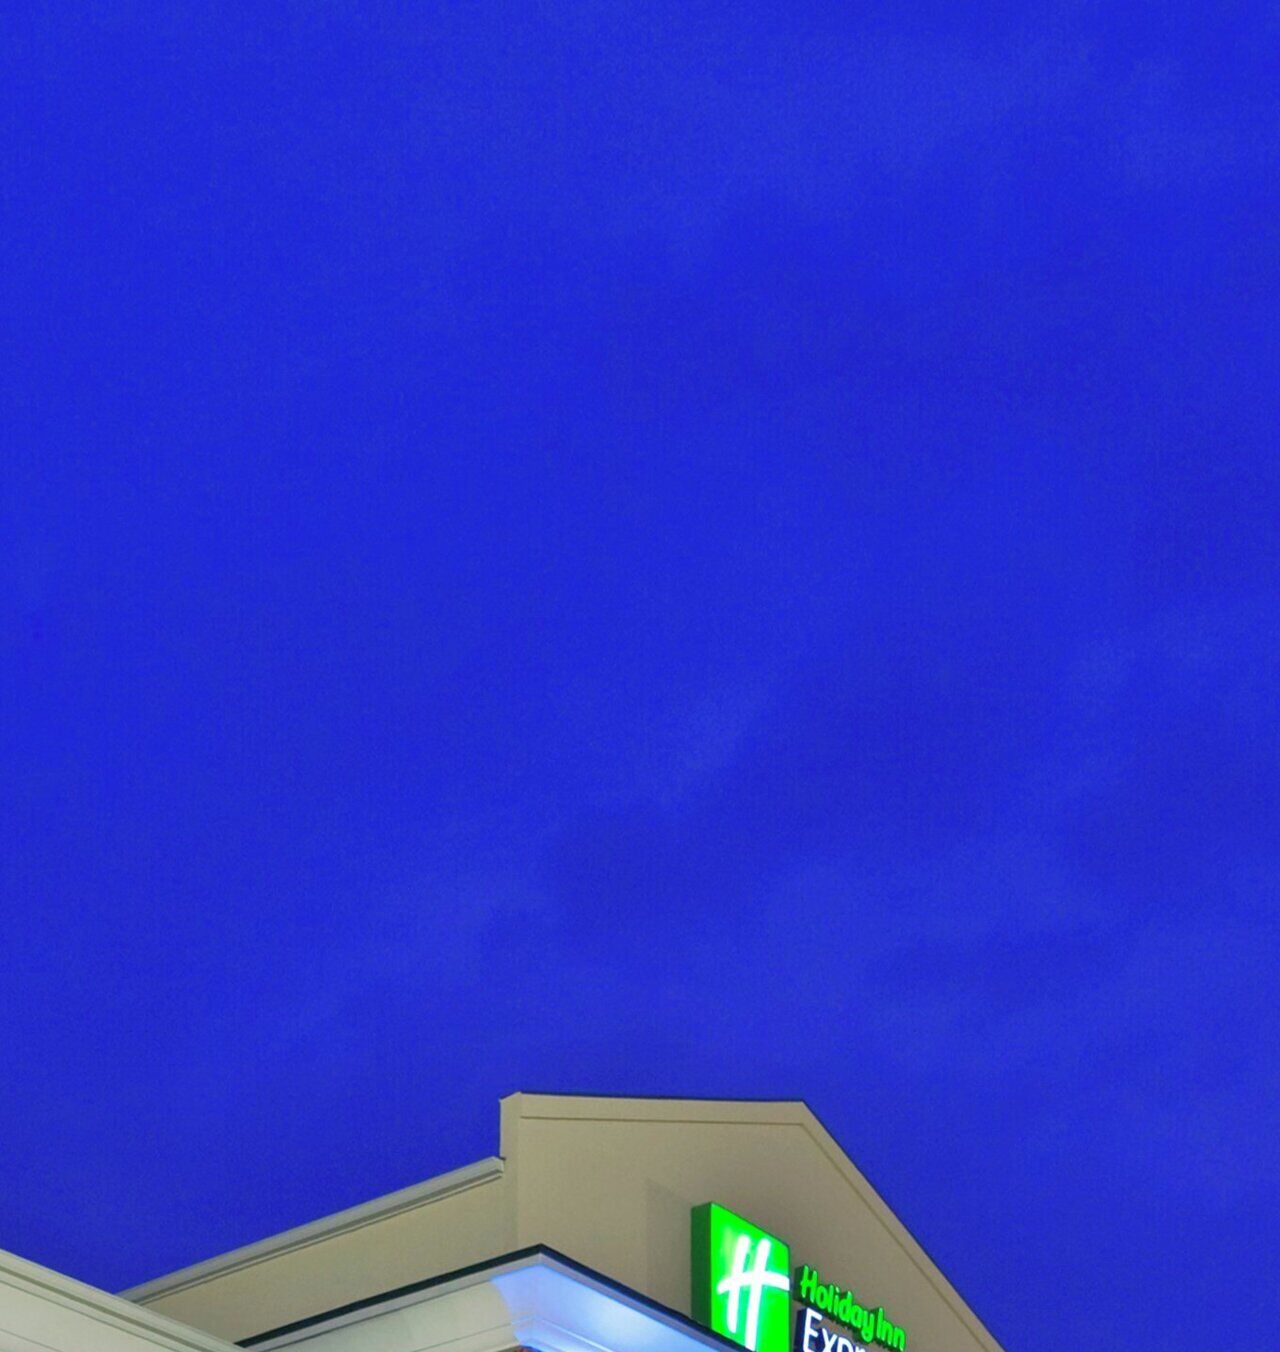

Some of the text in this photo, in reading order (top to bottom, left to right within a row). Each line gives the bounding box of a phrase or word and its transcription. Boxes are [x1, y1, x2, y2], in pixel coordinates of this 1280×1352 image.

[717, 1235, 790, 1351] H
[800, 1266, 906, 1351] Holiday Inn
